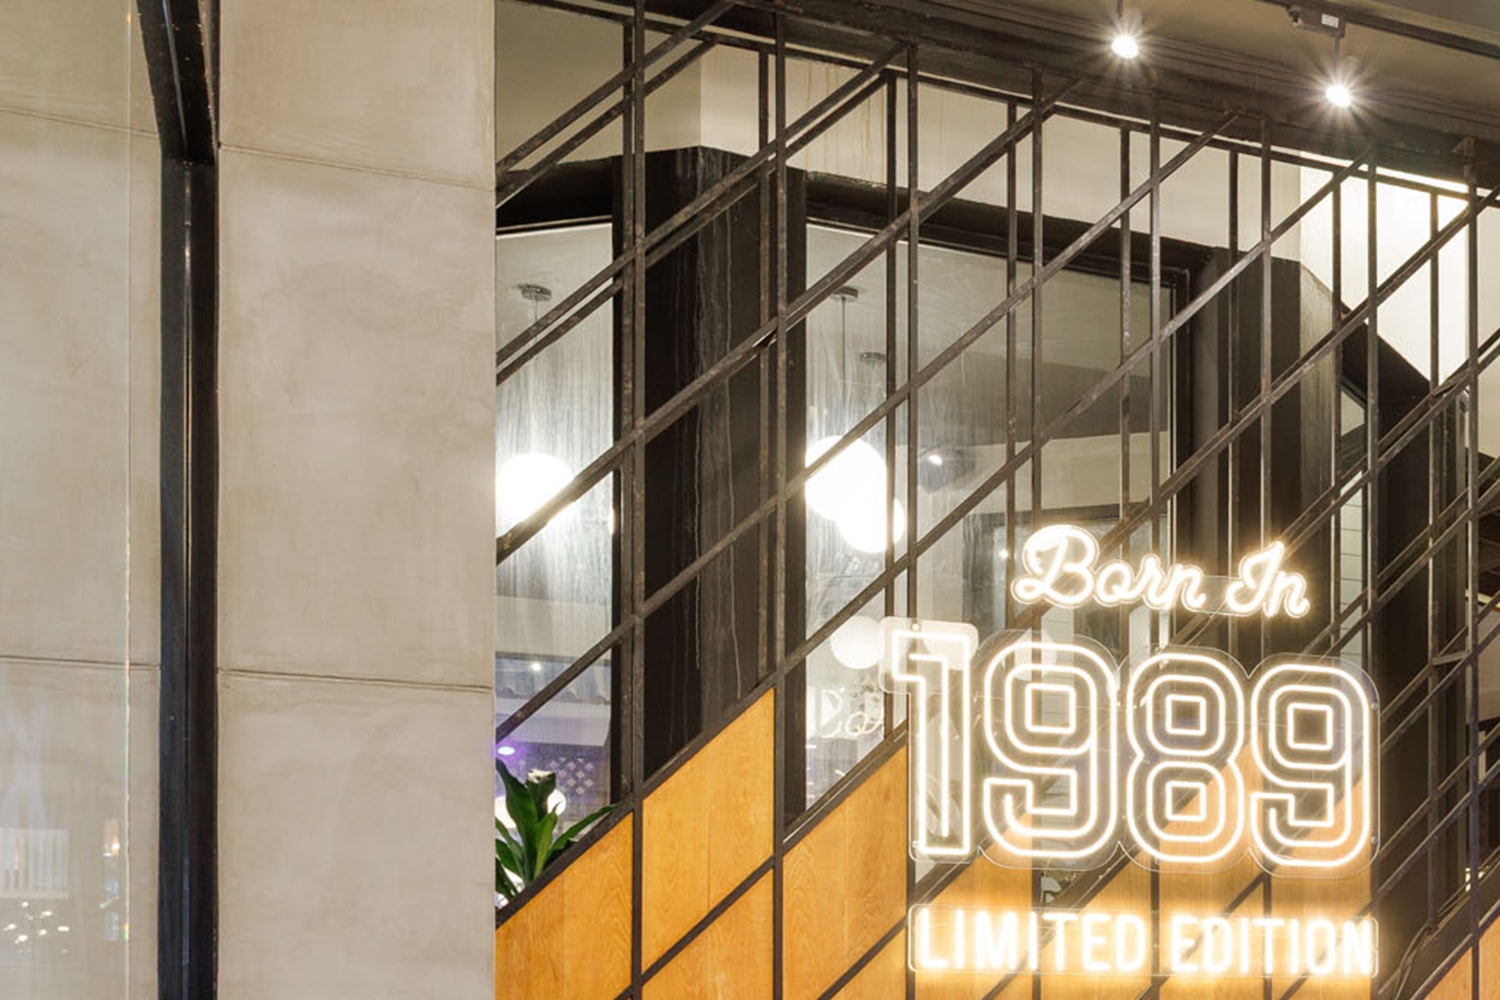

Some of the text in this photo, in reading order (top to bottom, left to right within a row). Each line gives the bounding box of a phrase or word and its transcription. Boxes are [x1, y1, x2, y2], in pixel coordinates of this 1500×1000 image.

[1013, 524, 1310, 617] Born In
[891, 630, 1371, 867] 1989
[918, 907, 1374, 976] LIMITED EDITION
